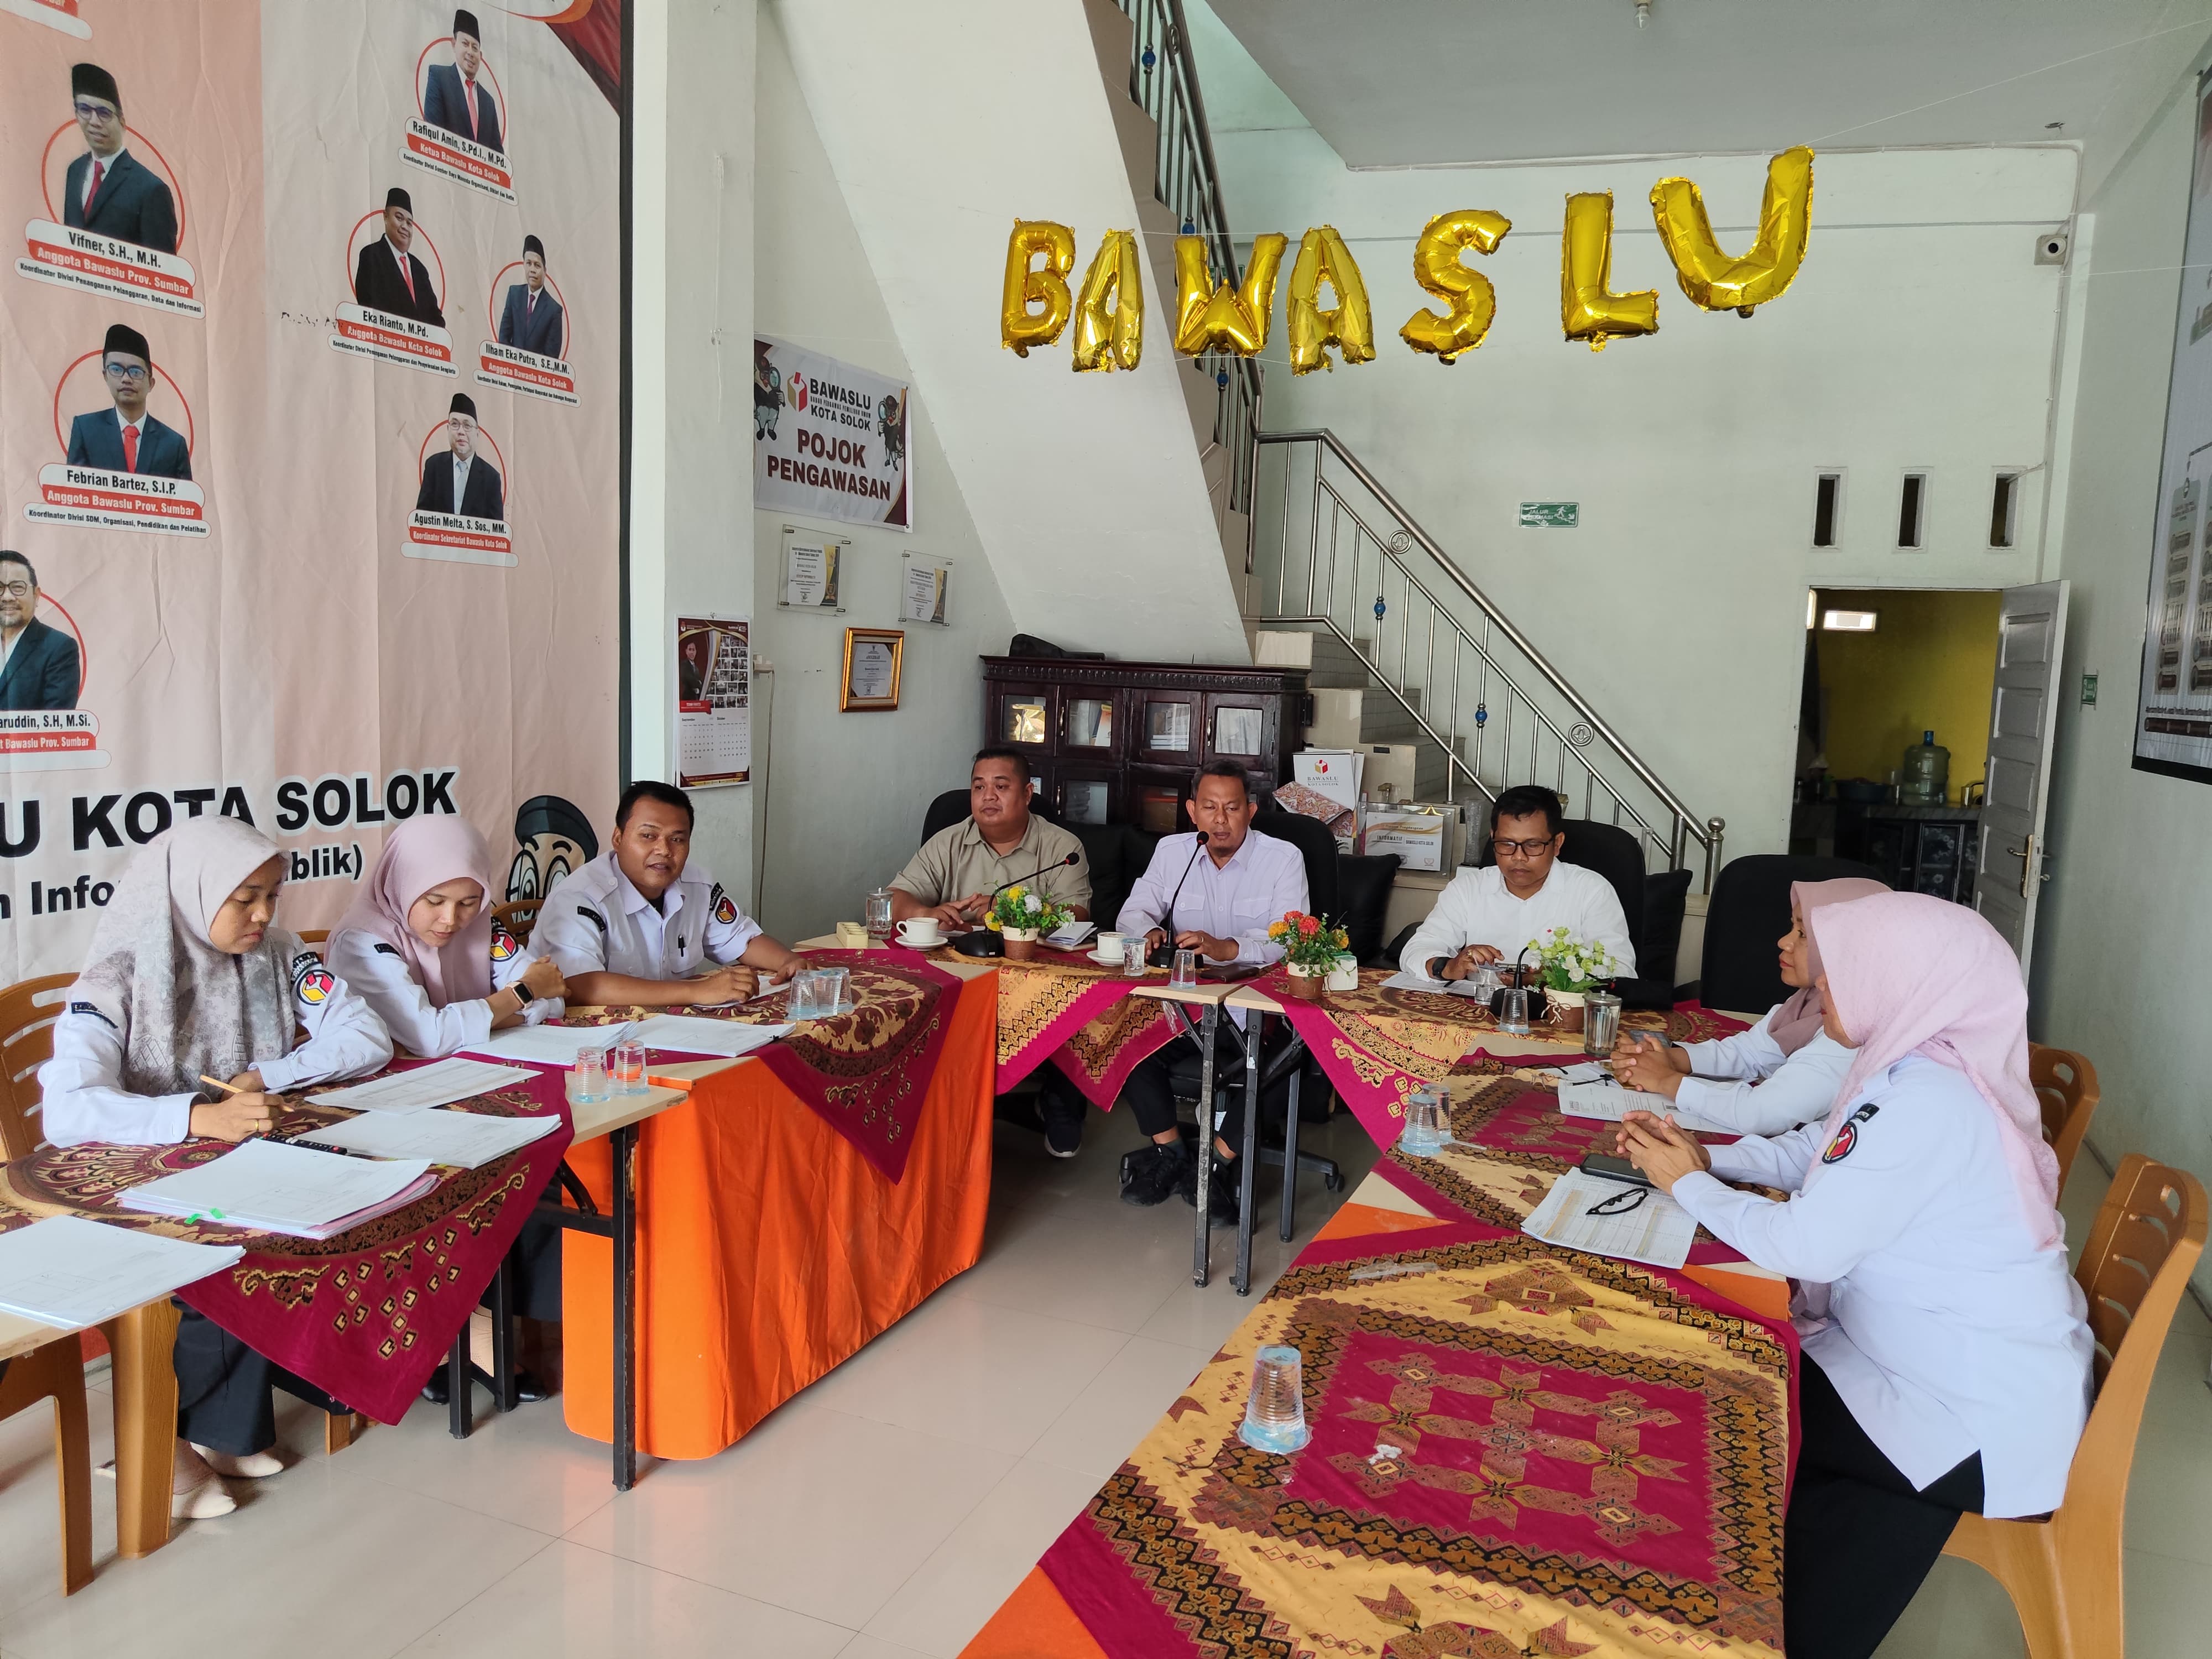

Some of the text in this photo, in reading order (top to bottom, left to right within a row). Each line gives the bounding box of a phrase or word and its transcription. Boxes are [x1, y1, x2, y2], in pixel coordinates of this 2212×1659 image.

[413, 121, 439, 140] Rafiqul
[441, 132, 460, 152] Amin,
[488, 152, 507, 169] M.Pd.
[420, 143, 500, 182] Ketua Bawaslu Kota Solok
[68, 231, 161, 268] Vifner, S.H., M.H.
[1001, 144, 1815, 375] BAWASLU
[37, 247, 189, 295] Anggota Bawaslu Prov. Sumbar
[20, 263, 56, 277] Koordinator
[57, 272, 74, 281] Divisi
[113, 285, 149, 301] Pelanggaran,
[152, 295, 164, 304] Data
[176, 301, 201, 313] Informasi
[363, 310, 429, 337] Eka Rianto, M.Pd.
[347, 326, 442, 358] Anggota Bawaslu Kota Solok
[486, 343, 504, 357] Ilham
[505, 348, 517, 361] Eka
[519, 352, 537, 368] Putra,
[488, 362, 567, 389] Anggota Bawaslu Kota Solok
[810, 378, 871, 410] BAWASLU
[811, 404, 871, 431] KOTA SOLOK
[797, 428, 867, 468] POJOK
[67, 469, 176, 495] Febrian Bartez, S.I.P.
[767, 455, 890, 501] PENGAWASAN
[47, 490, 195, 516] Anggota Bawaslu Prov. Sumbar
[29, 509, 66, 519] Koordinator
[67, 513, 84, 521] Divisi
[86, 515, 102, 524] SDM,
[103, 517, 135, 527] Organisasi,
[137, 520, 168, 529] Pendidikan
[181, 525, 206, 534] Pelatihan
[414, 513, 441, 525] Agustin
[467, 520, 473, 530] S.
[492, 523, 507, 534] MM.
[43, 714, 63, 729] S.H,
[66, 714, 91, 727] M.Si.
[6, 737, 38, 749] Bawaslu
[40, 737, 60, 748] Prov.
[61, 736, 89, 747] Sumbar
[72, 786, 256, 852] KOTA
[276, 771, 457, 831] SOLOK
[32, 875, 121, 915] Info
[284, 844, 362, 881] blik)
